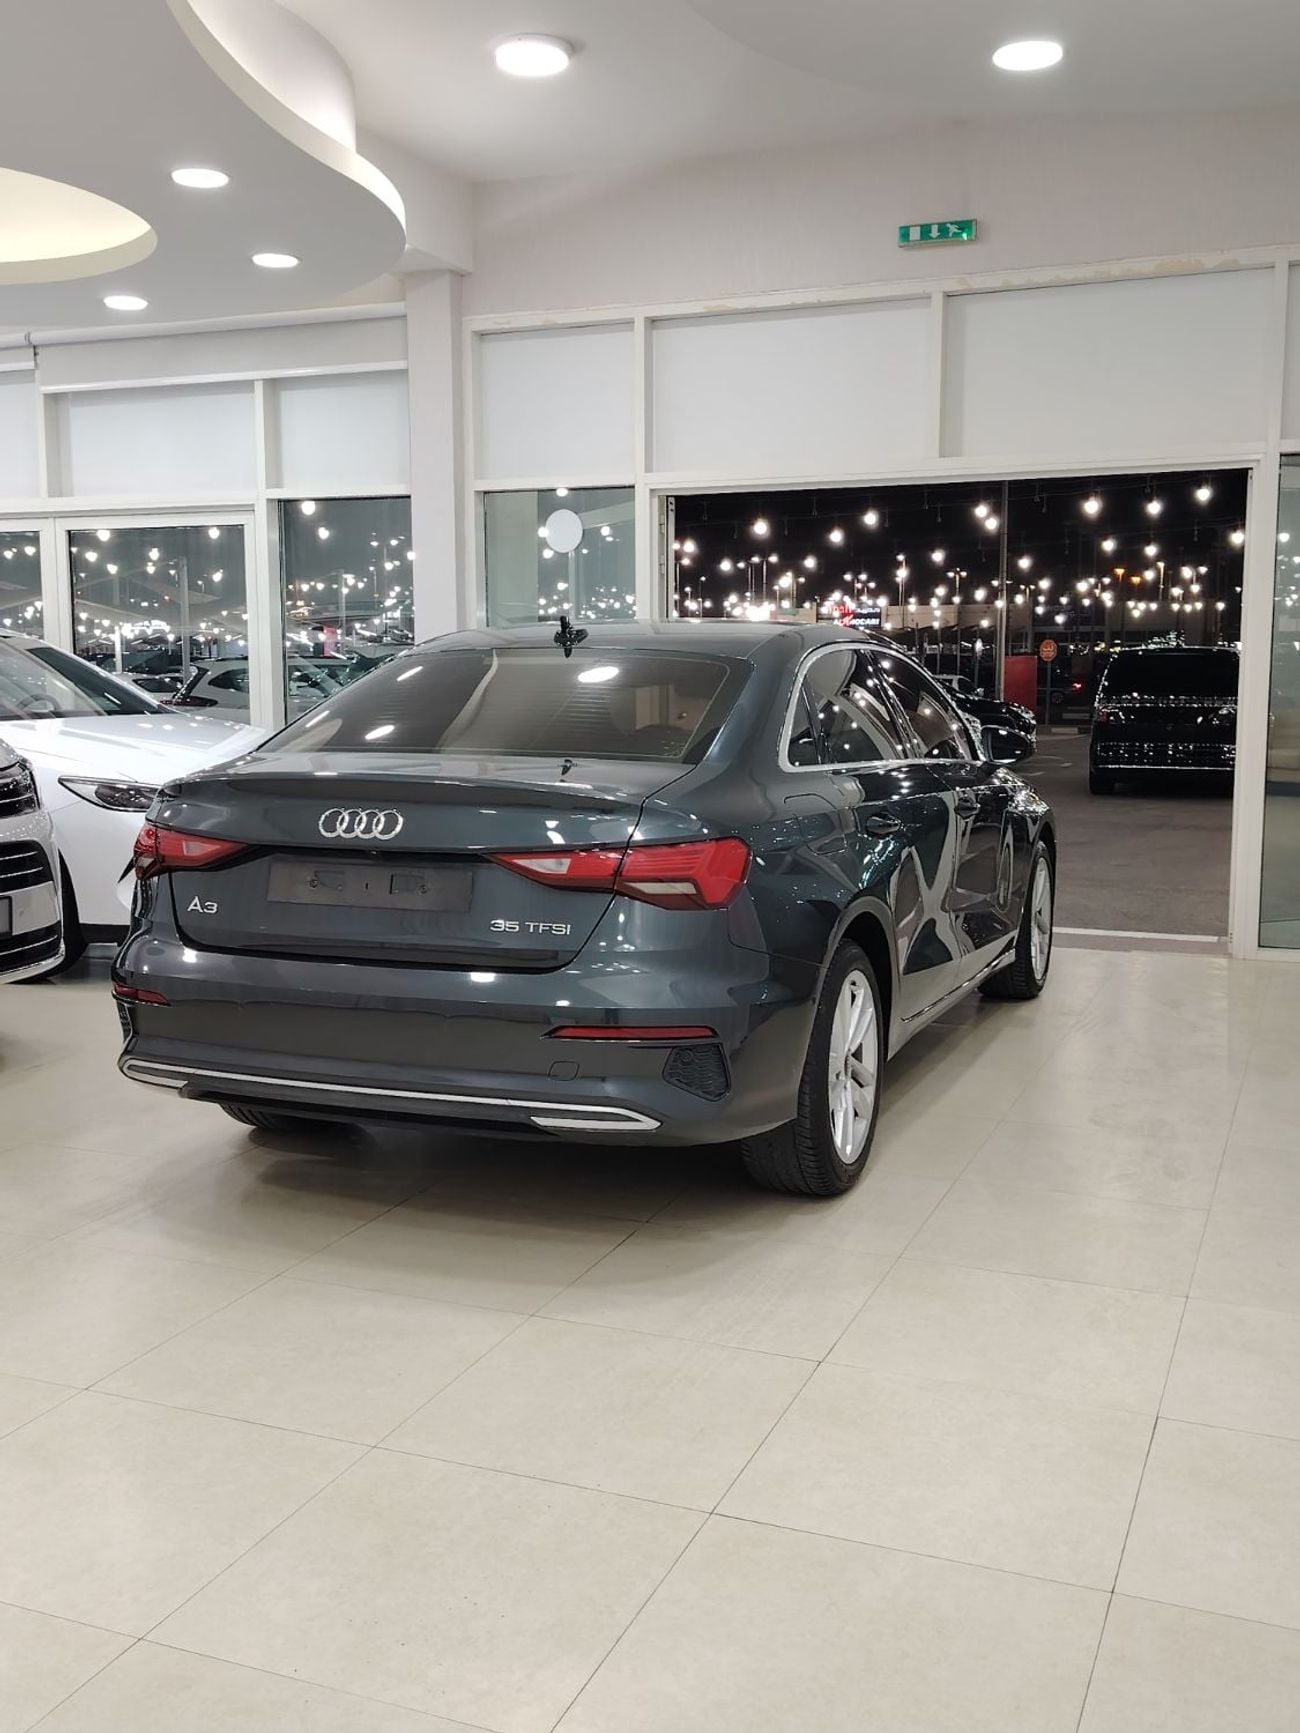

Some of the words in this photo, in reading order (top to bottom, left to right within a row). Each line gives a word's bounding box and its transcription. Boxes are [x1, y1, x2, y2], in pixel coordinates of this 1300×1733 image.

[187, 895, 218, 914] A3
[490, 919, 519, 932] 35
[525, 921, 571, 935] TFSI
